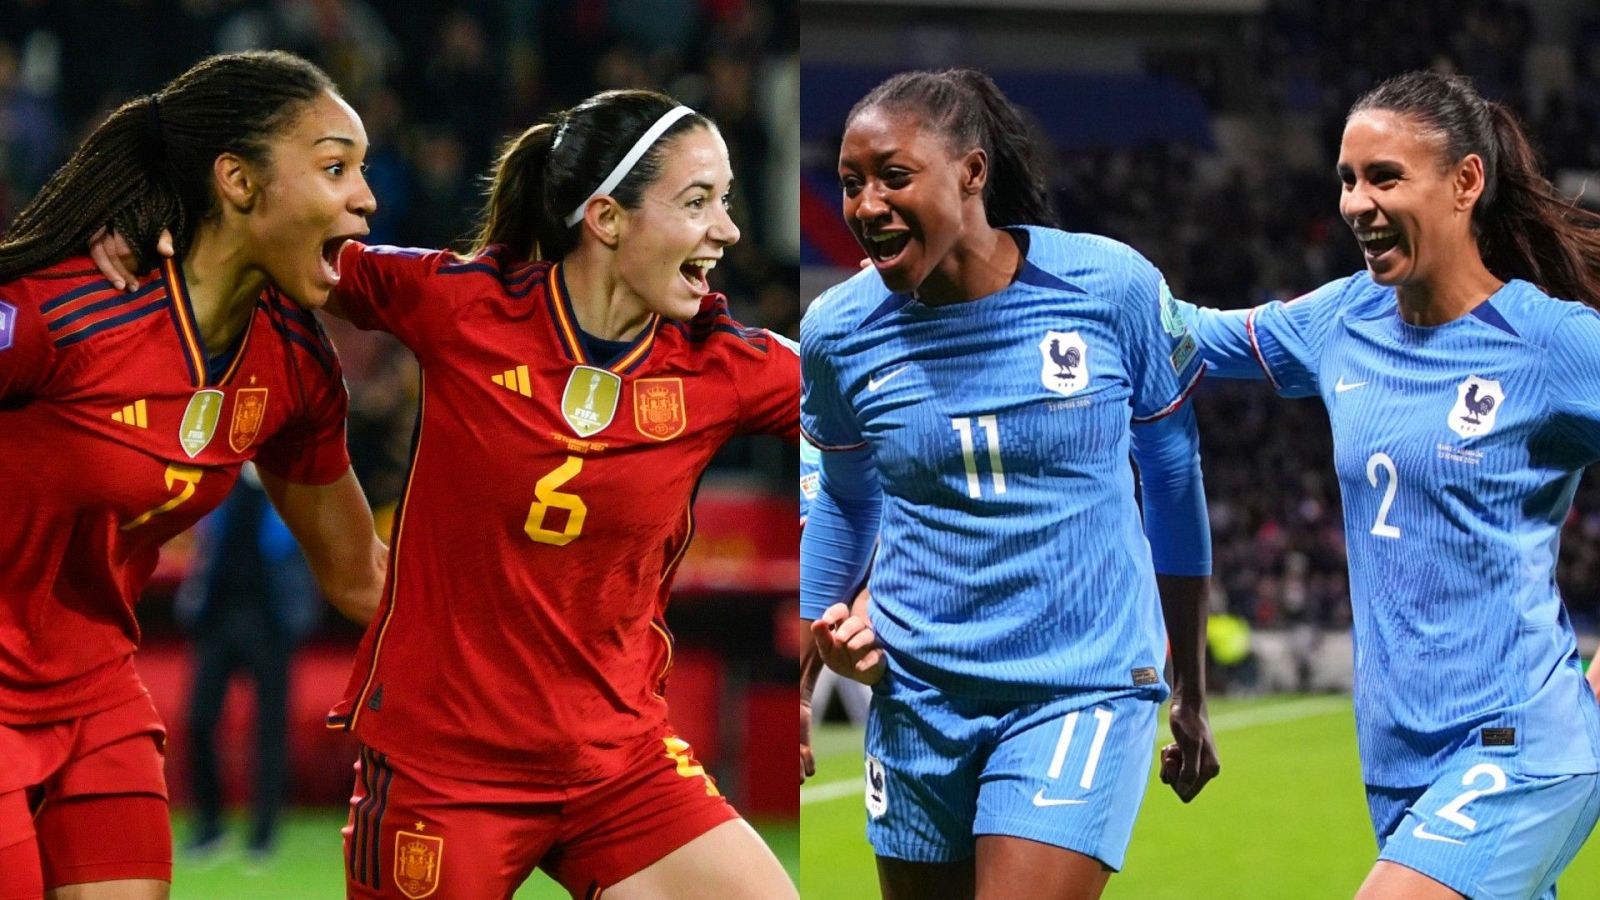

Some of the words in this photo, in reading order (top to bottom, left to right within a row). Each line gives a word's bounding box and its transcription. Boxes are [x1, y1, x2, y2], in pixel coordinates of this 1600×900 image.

[574, 407, 598, 421] FIFA
[119, 463, 203, 531] 7
[951, 415, 1007, 499] 11
[1366, 452, 1401, 539] 2
[524, 455, 587, 546] 6
[1047, 707, 1113, 790] 11
[1434, 763, 1507, 832] 2
